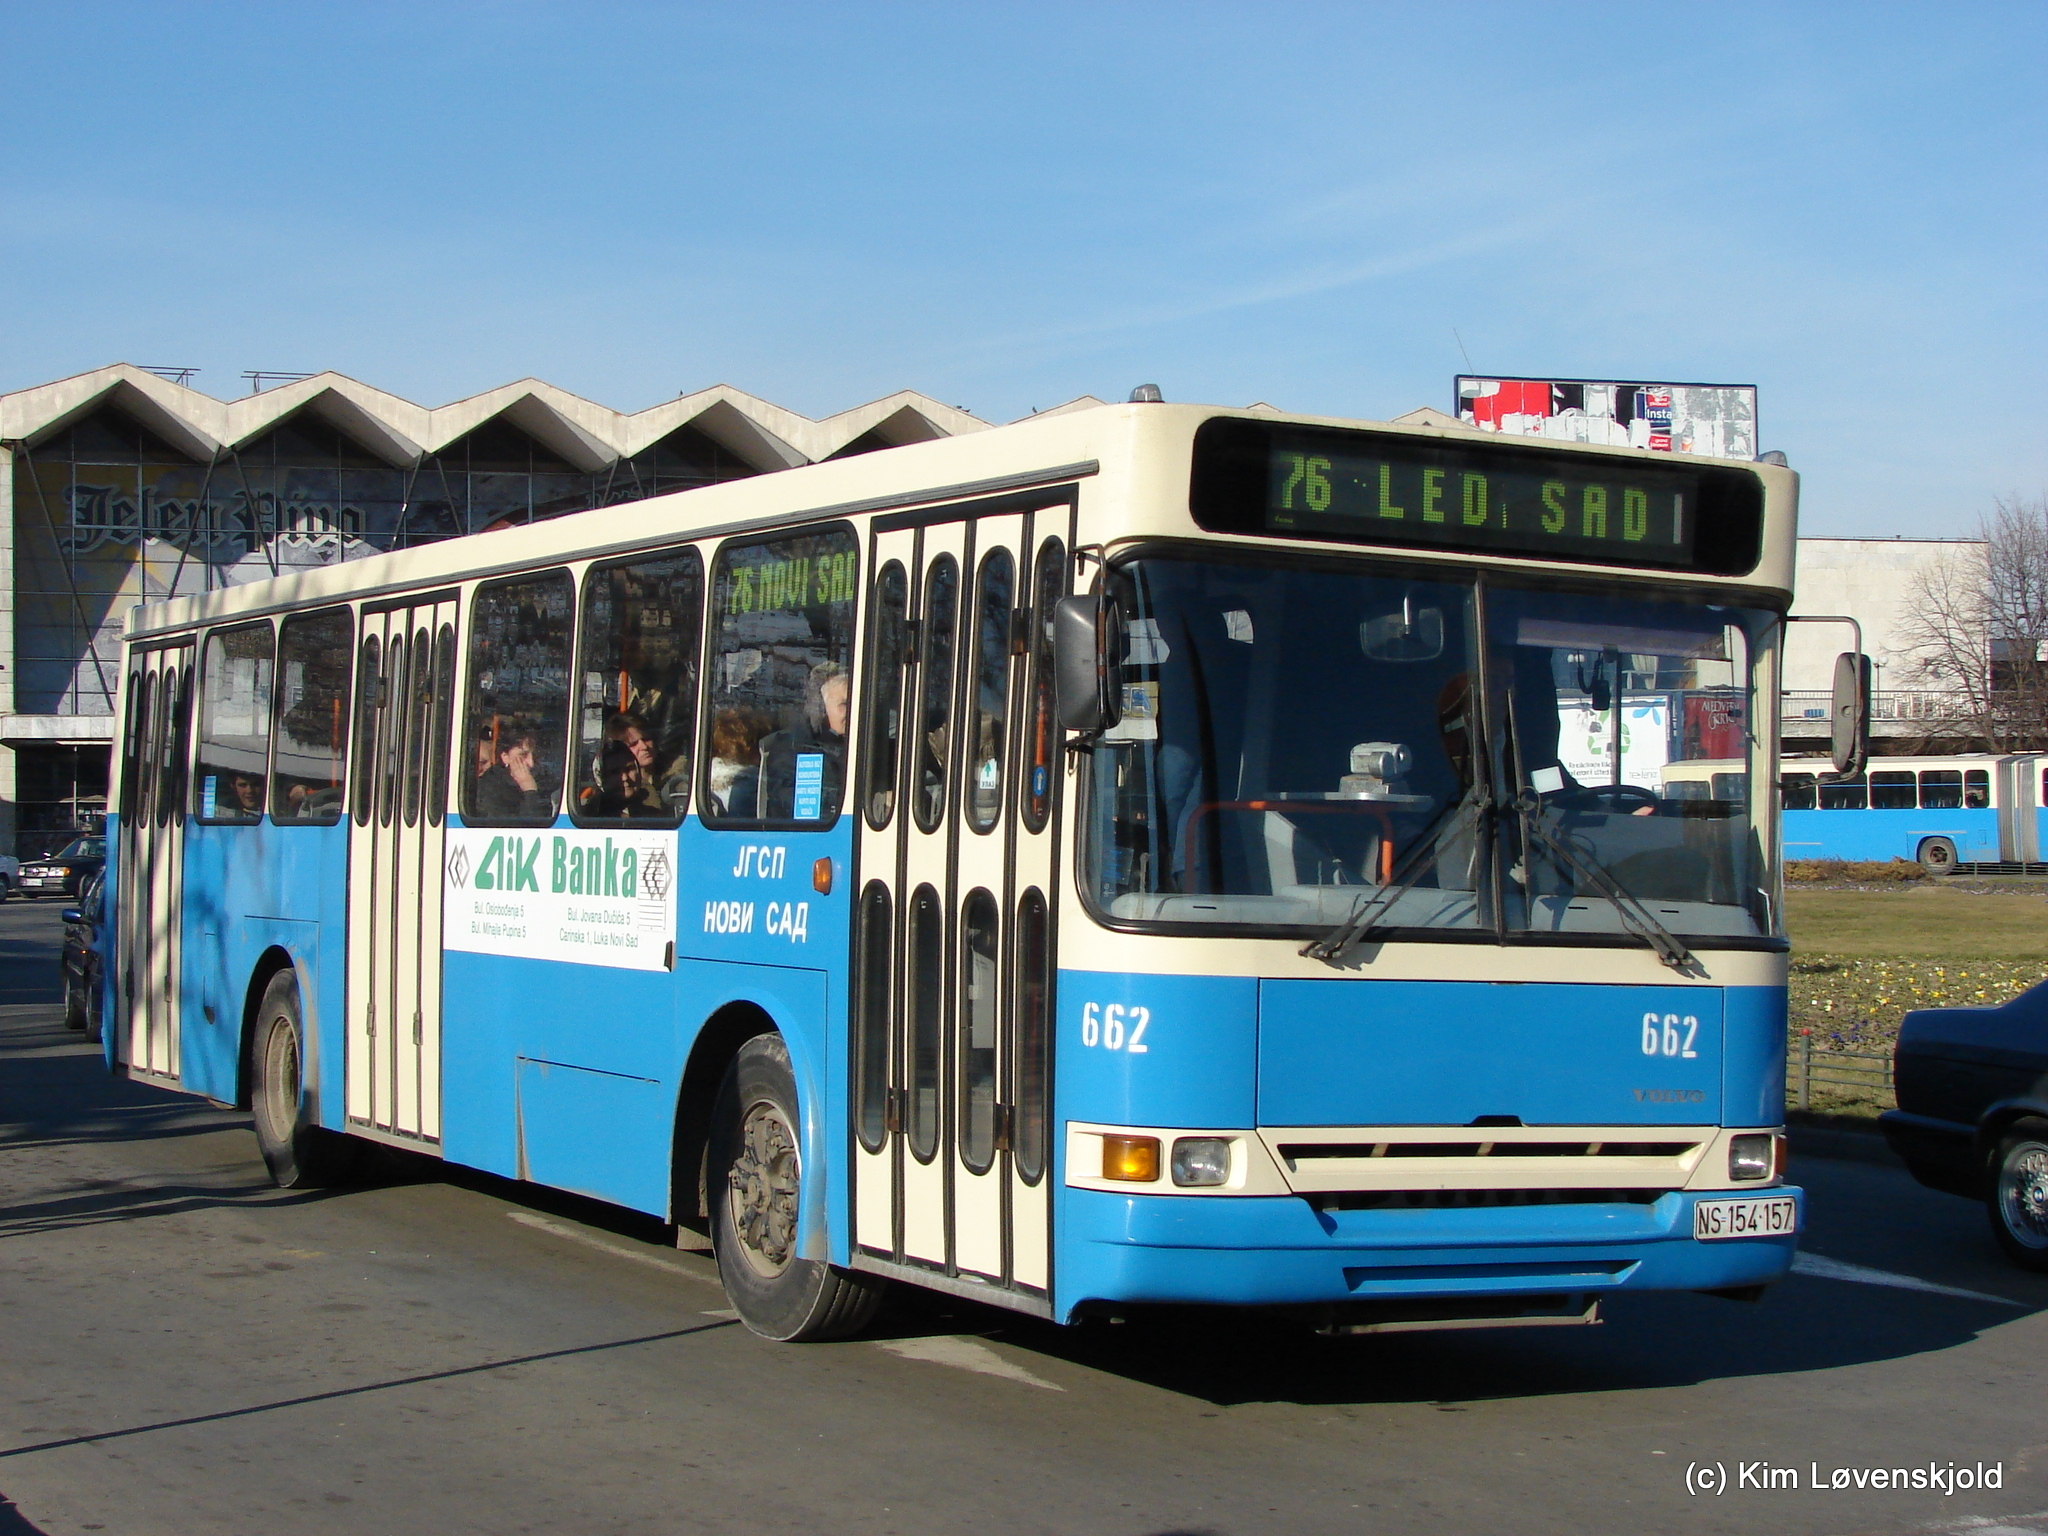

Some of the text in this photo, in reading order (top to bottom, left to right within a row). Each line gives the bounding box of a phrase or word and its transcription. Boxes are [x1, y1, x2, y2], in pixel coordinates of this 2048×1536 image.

[62, 484, 223, 552] Jelen
[1279, 452, 1647, 541] 76 LED SAD
[732, 566, 753, 614] 76
[759, 557, 809, 611] NOVI
[552, 836, 637, 898] Banka
[594, 931, 608, 945] Luka
[610, 933, 624, 947] Novi
[626, 933, 638, 947] Sad
[626, 912, 631, 925] 5
[704, 901, 809, 943] НОВИ САД
[1082, 1001, 1150, 1053] 662
[1641, 1012, 1698, 1058] 662
[1632, 1089, 1705, 1103] VOLVO
